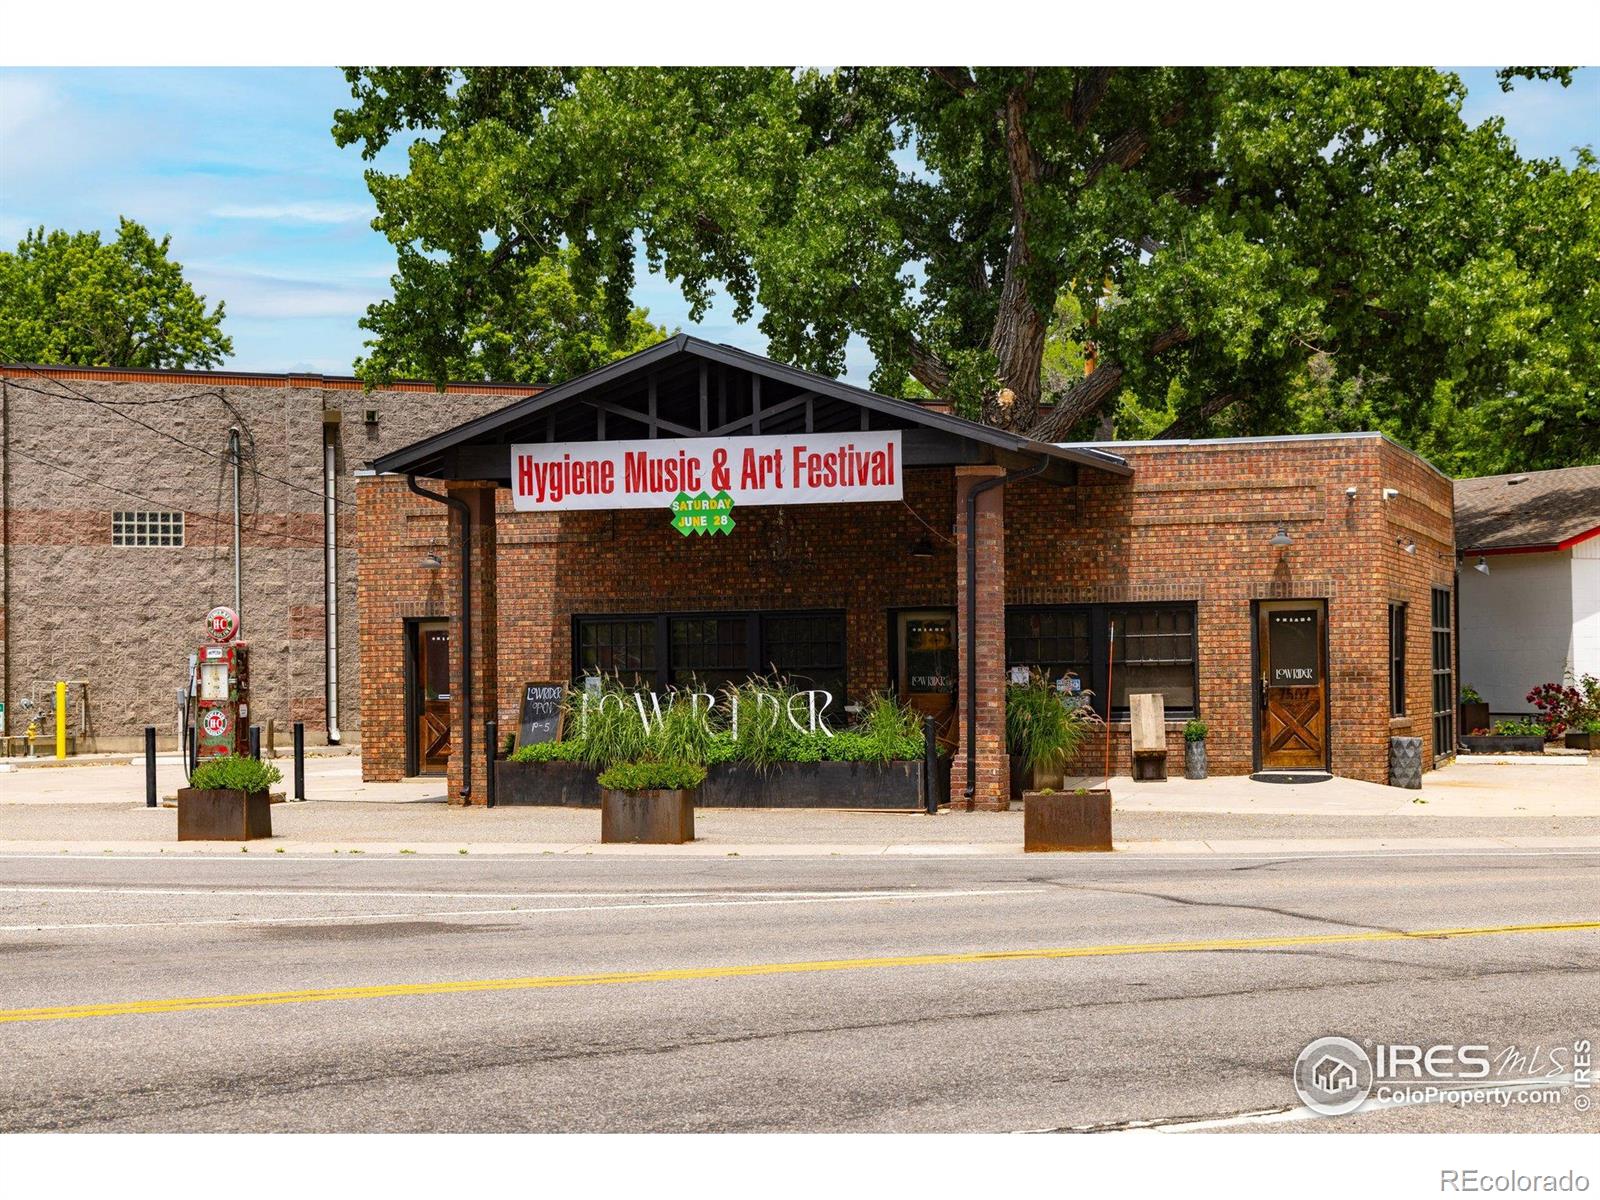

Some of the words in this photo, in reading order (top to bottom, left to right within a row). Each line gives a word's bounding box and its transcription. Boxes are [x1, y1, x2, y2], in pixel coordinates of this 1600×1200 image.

[517, 453, 615, 503] Hygiene
[625, 449, 701, 494] Music
[711, 447, 732, 492] &
[740, 446, 783, 490] Art
[793, 442, 894, 489] Festival
[672, 498, 731, 511] SATURDAY
[678, 515, 707, 527] JUNE
[713, 515, 728, 526] 28
[1275, 668, 1313, 680] LOWRIDER
